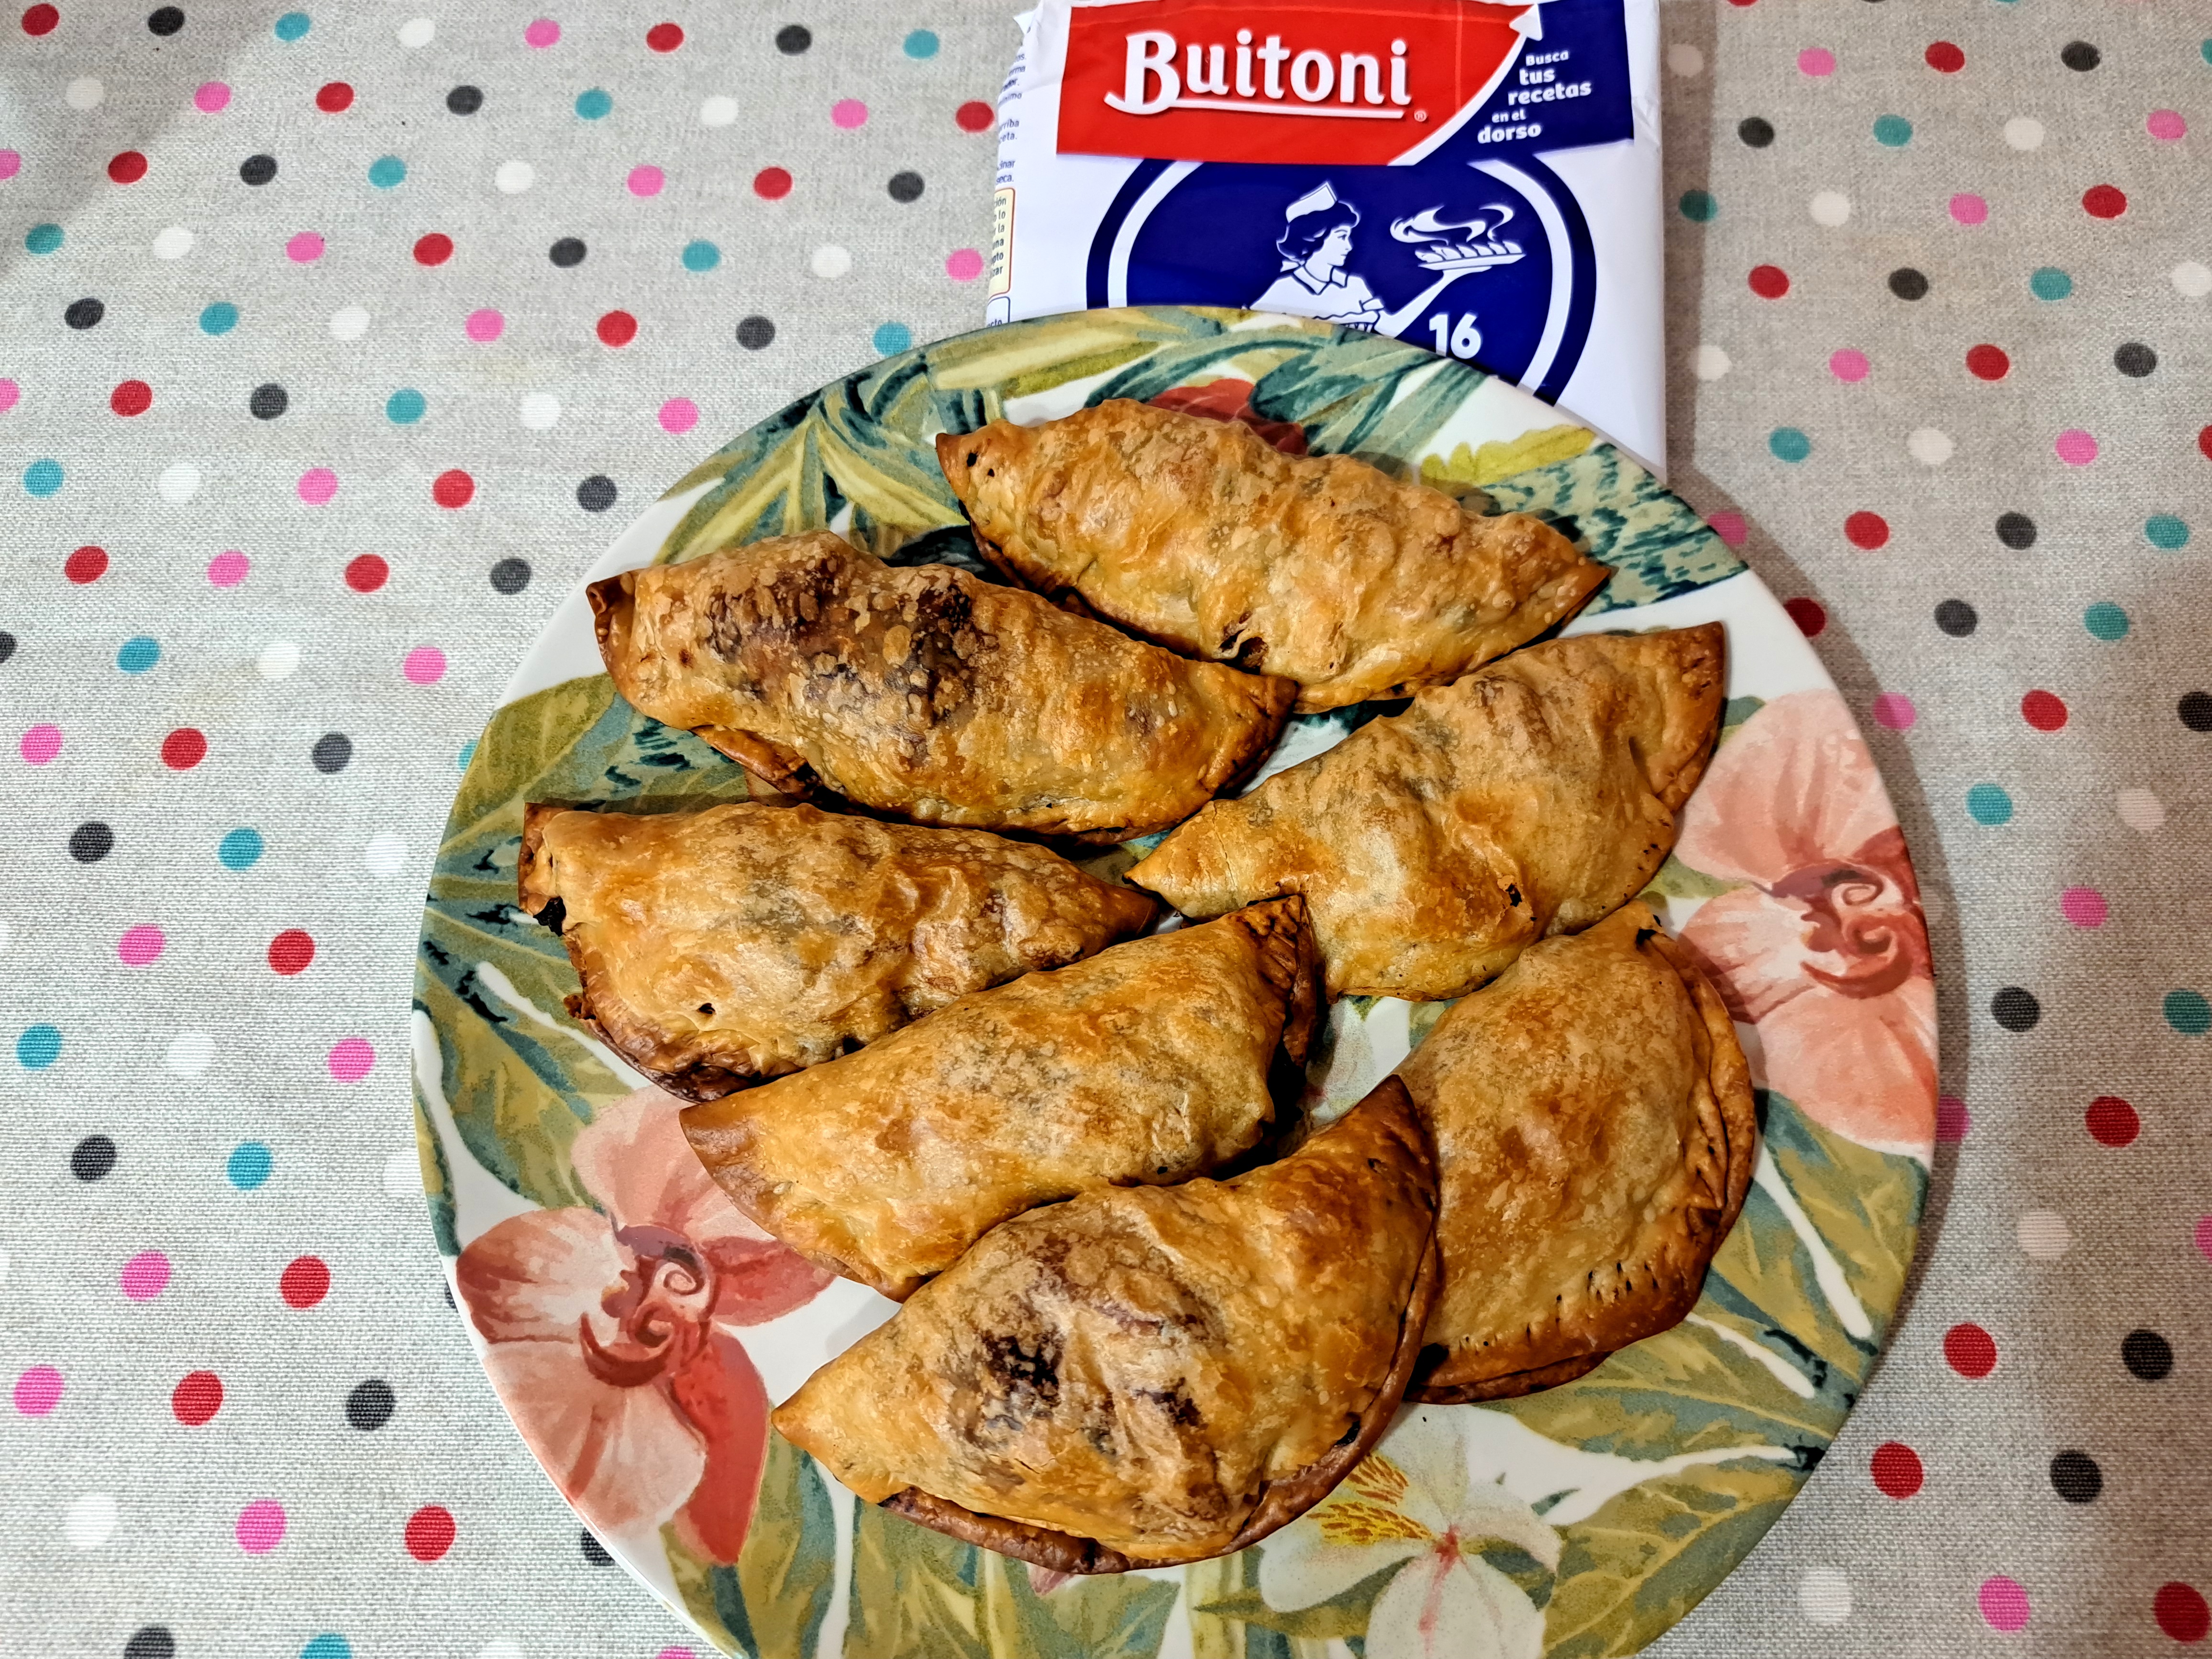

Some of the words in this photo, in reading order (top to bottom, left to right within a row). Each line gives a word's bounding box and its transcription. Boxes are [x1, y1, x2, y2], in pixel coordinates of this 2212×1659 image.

[1526, 50, 1570, 66] Busca
[1104, 29, 1412, 115] Buitoni
[1519, 68, 1556, 85] tus
[1508, 81, 1592, 105] recetas
[1492, 111, 1509, 123] en
[1512, 108, 1526, 121] el
[1477, 122, 1542, 144] dorso
[998, 210, 1006, 220] lo
[998, 223, 1005, 233] la
[1428, 312, 1482, 359] 16
